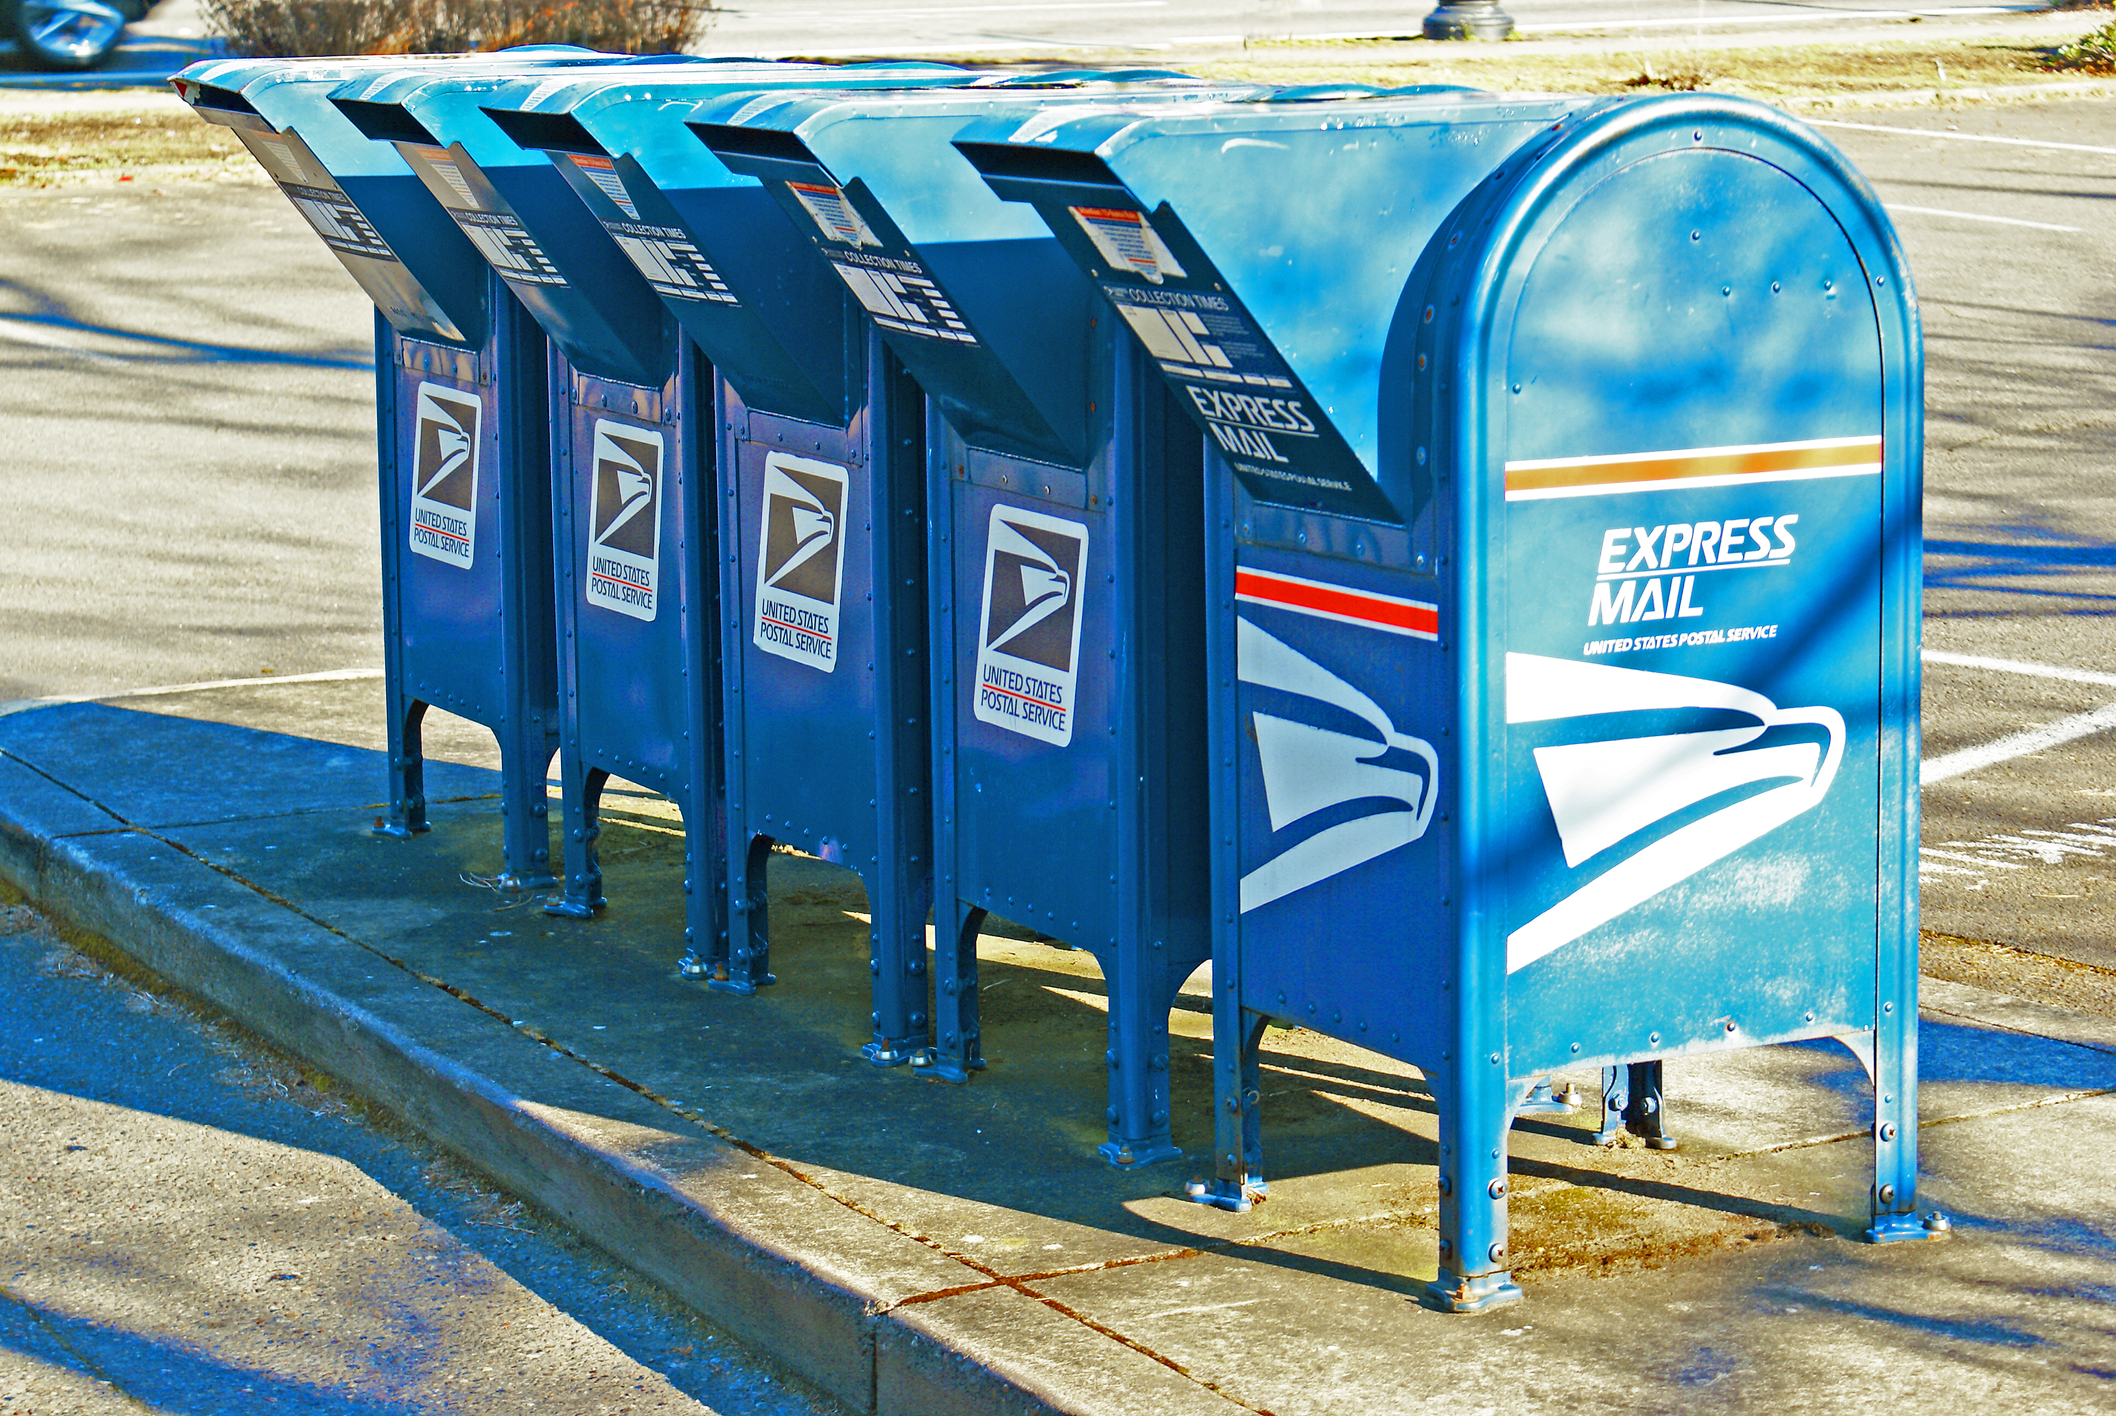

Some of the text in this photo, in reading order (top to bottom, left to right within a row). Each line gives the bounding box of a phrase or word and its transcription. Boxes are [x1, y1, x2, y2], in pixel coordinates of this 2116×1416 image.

[465, 212, 502, 225] COLLECTION
[497, 215, 519, 226] TIMES
[621, 222, 665, 237] COLLECTION
[662, 227, 687, 240] TIMES
[844, 250, 896, 269] COLLECTION
[893, 259, 922, 274] TIMES
[1128, 288, 1195, 308] COLLECTION
[1192, 294, 1229, 311] TIMES
[1185, 385, 1316, 432] EXPRESS
[1209, 422, 1289, 463] MAIL
[415, 507, 467, 537] UNITED STATES
[414, 527, 470, 558] POSTAL SERVICE
[1598, 514, 1799, 574] EXPRESS
[592, 555, 650, 587] UNITED STATES
[591, 577, 653, 609] POSTAL SERVICE
[1588, 575, 1704, 627] MAIL
[762, 598, 829, 634] UNITED STATES
[760, 621, 832, 659] POSTAL SERVICE
[1583, 624, 1778, 656] UNITED STATES POSTAL SERVICE
[983, 663, 1063, 704] UNITED STATES
[981, 688, 1066, 731] POSTAL SERVICE
